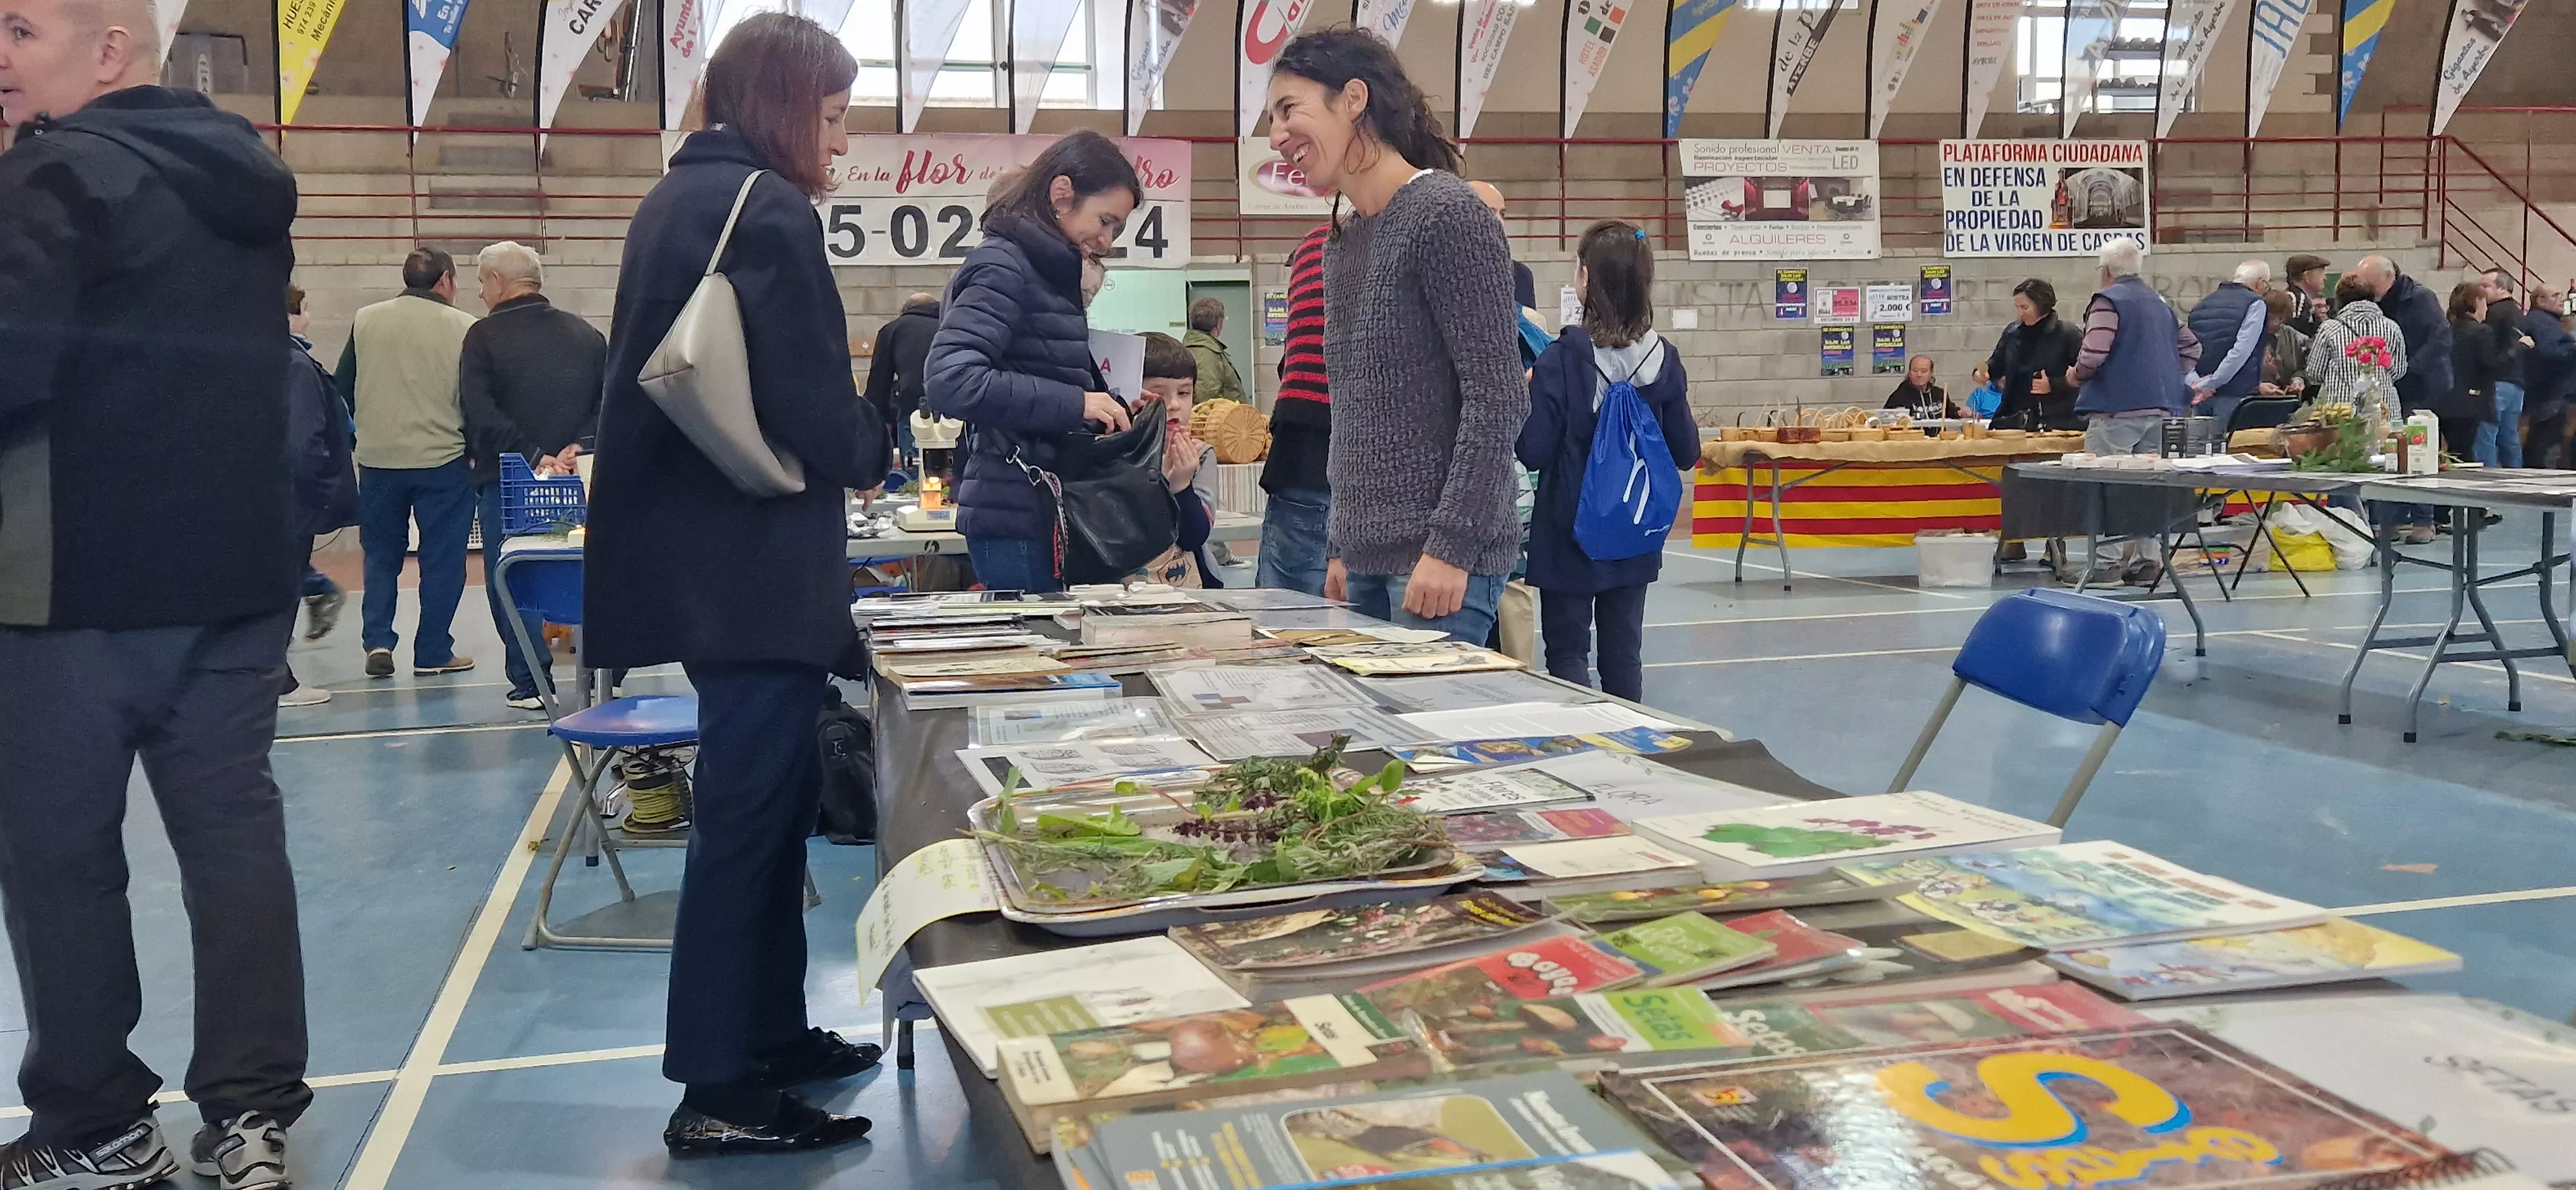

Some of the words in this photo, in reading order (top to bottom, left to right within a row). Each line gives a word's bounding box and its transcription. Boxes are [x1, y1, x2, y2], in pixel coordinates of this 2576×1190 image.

[1482, 62, 1493, 79] DEL
[1490, 29, 1506, 60] CAMPO
[1694, 144, 1726, 154] Sonido
[1729, 143, 1779, 156] profesional
[1782, 144, 1832, 154] VENTA
[1944, 144, 2047, 162] PLATAFORMA
[2052, 144, 2143, 162] CIUDADANA
[847, 165, 871, 182] En
[874, 169, 893, 182] la
[896, 150, 974, 194] flor
[1694, 162, 1788, 173] PROYECTOS
[1832, 155, 1859, 170] LED
[1944, 167, 1965, 187] EN
[1971, 167, 2047, 187] DEFENSA
[1971, 191, 1993, 207] DE
[1999, 191, 2020, 207] LA
[1946, 210, 2043, 230] PROPIEDAD
[1730, 234, 1826, 244] ALQUILERES
[1946, 233, 1965, 252] DE
[1971, 233, 1991, 252] LA
[1995, 233, 2052, 252] VIRGEN
[2058, 233, 2078, 251] DE
[1484, 781, 1526, 801] Flores
[95, 1128, 144, 1158] salomon
